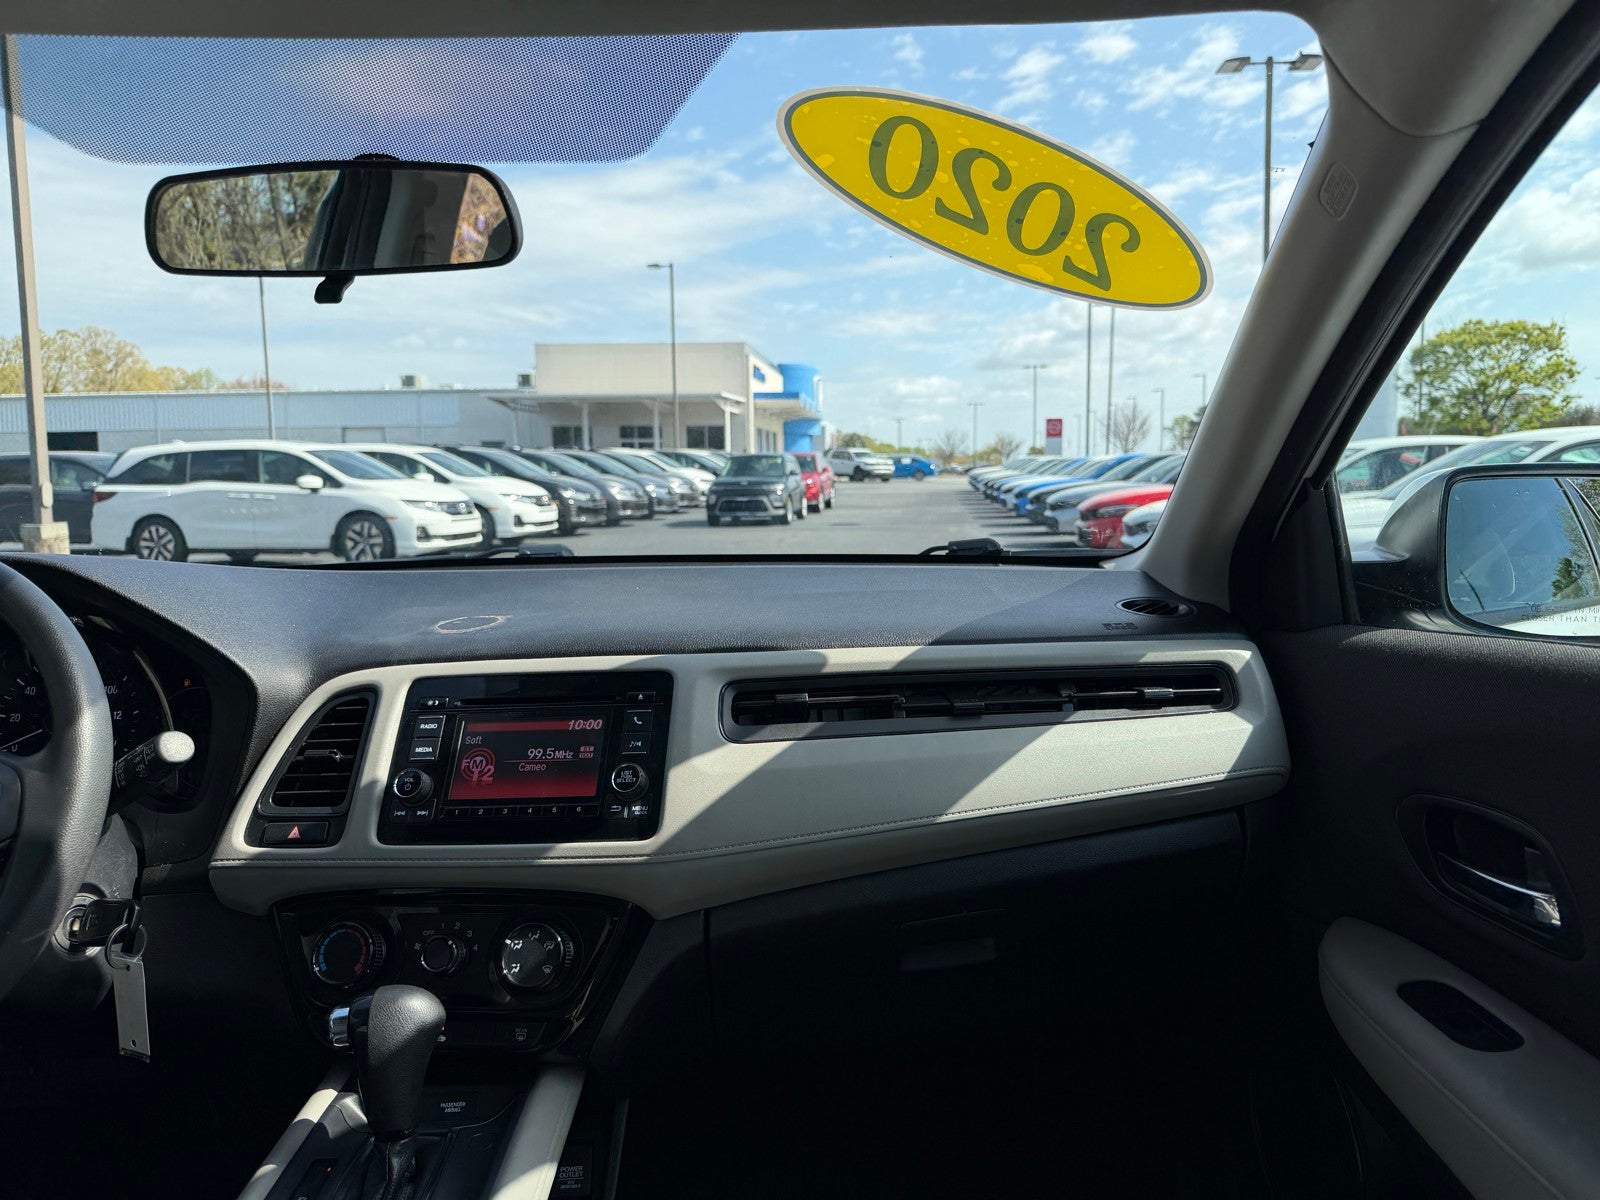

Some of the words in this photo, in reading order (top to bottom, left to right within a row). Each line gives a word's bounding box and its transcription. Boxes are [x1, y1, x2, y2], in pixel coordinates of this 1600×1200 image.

[1560, 615, 1587, 623] THAN
[24, 686, 37, 696] 40
[9, 713, 21, 723] 20
[567, 719, 603, 731] 10:00
[465, 736, 482, 745] Soft
[518, 762, 547, 772] Cameo
[559, 1165, 584, 1173] POWER
